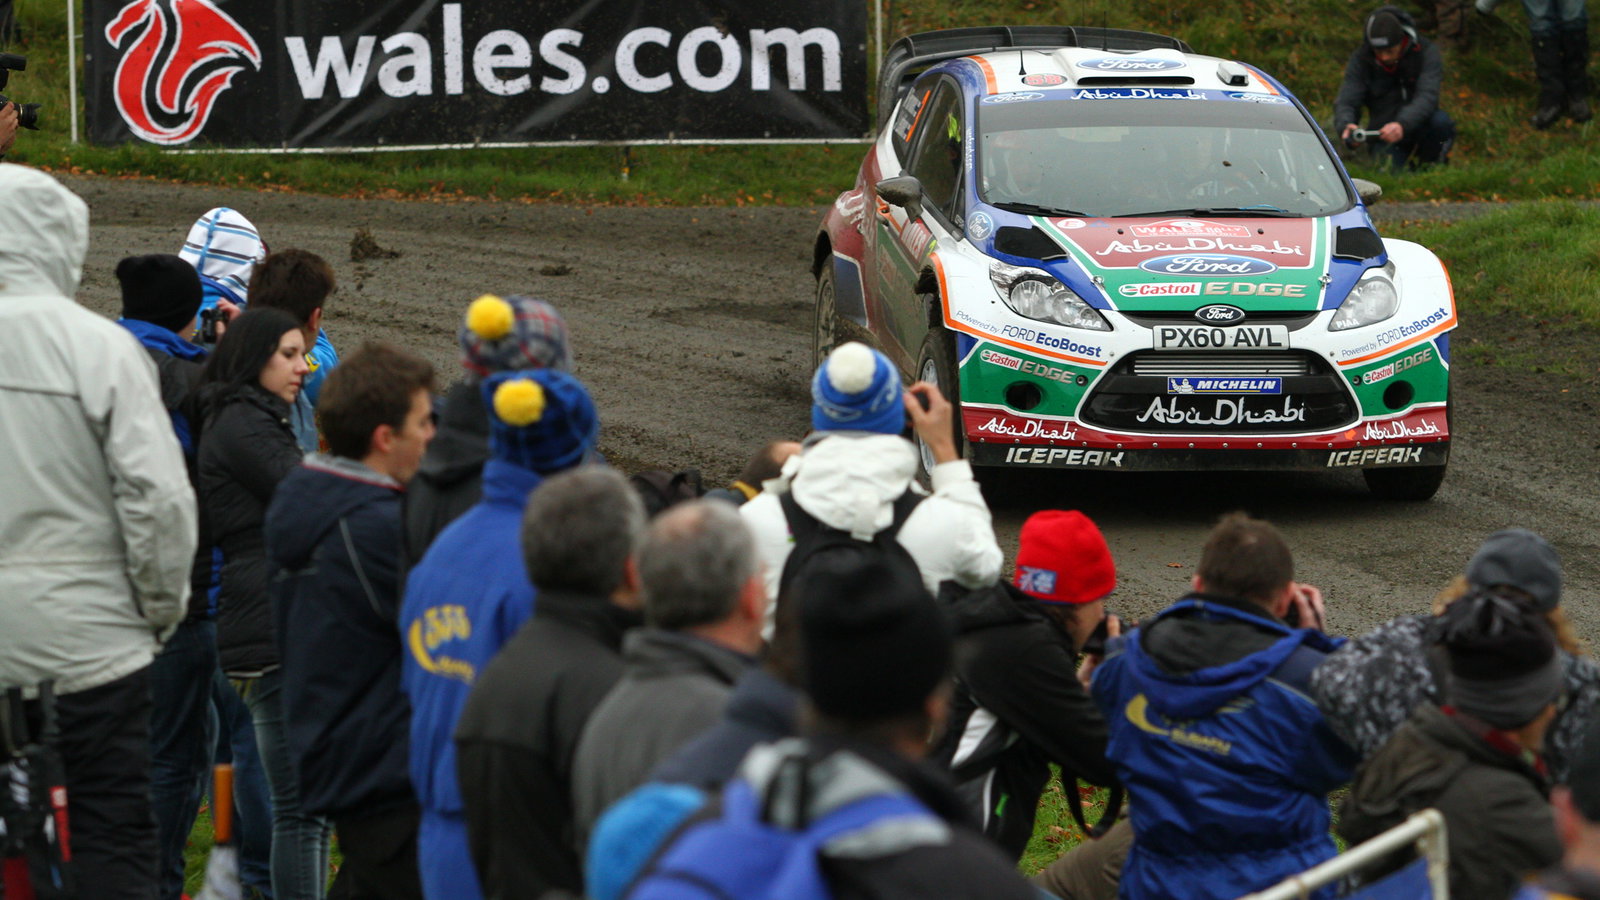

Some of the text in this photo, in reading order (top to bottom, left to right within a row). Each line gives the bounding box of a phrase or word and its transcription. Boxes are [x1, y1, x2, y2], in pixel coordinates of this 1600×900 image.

[285, 2, 842, 101] wales.com
[1099, 58, 1166, 69] Ford
[1136, 226, 1203, 234] WALES
[1166, 256, 1251, 274] Ford
[1140, 282, 1308, 298] Castrol EDGE
[1073, 318, 1102, 328] PIAA
[1206, 307, 1234, 320] Ford
[956, 310, 1102, 358] Powered by FORD EcoBoost
[1336, 319, 1360, 330] PIAA
[1341, 307, 1449, 357] Powered by FORD EcoBoost
[1161, 328, 1282, 348] PX60 AVL
[989, 352, 1076, 384] Castrol EDGE
[1371, 348, 1432, 381] Castrol EDGE
[1197, 380, 1276, 390] MICHELIN
[1007, 447, 1123, 467] ICEPEAK
[1326, 446, 1423, 468] ICEPEAK
